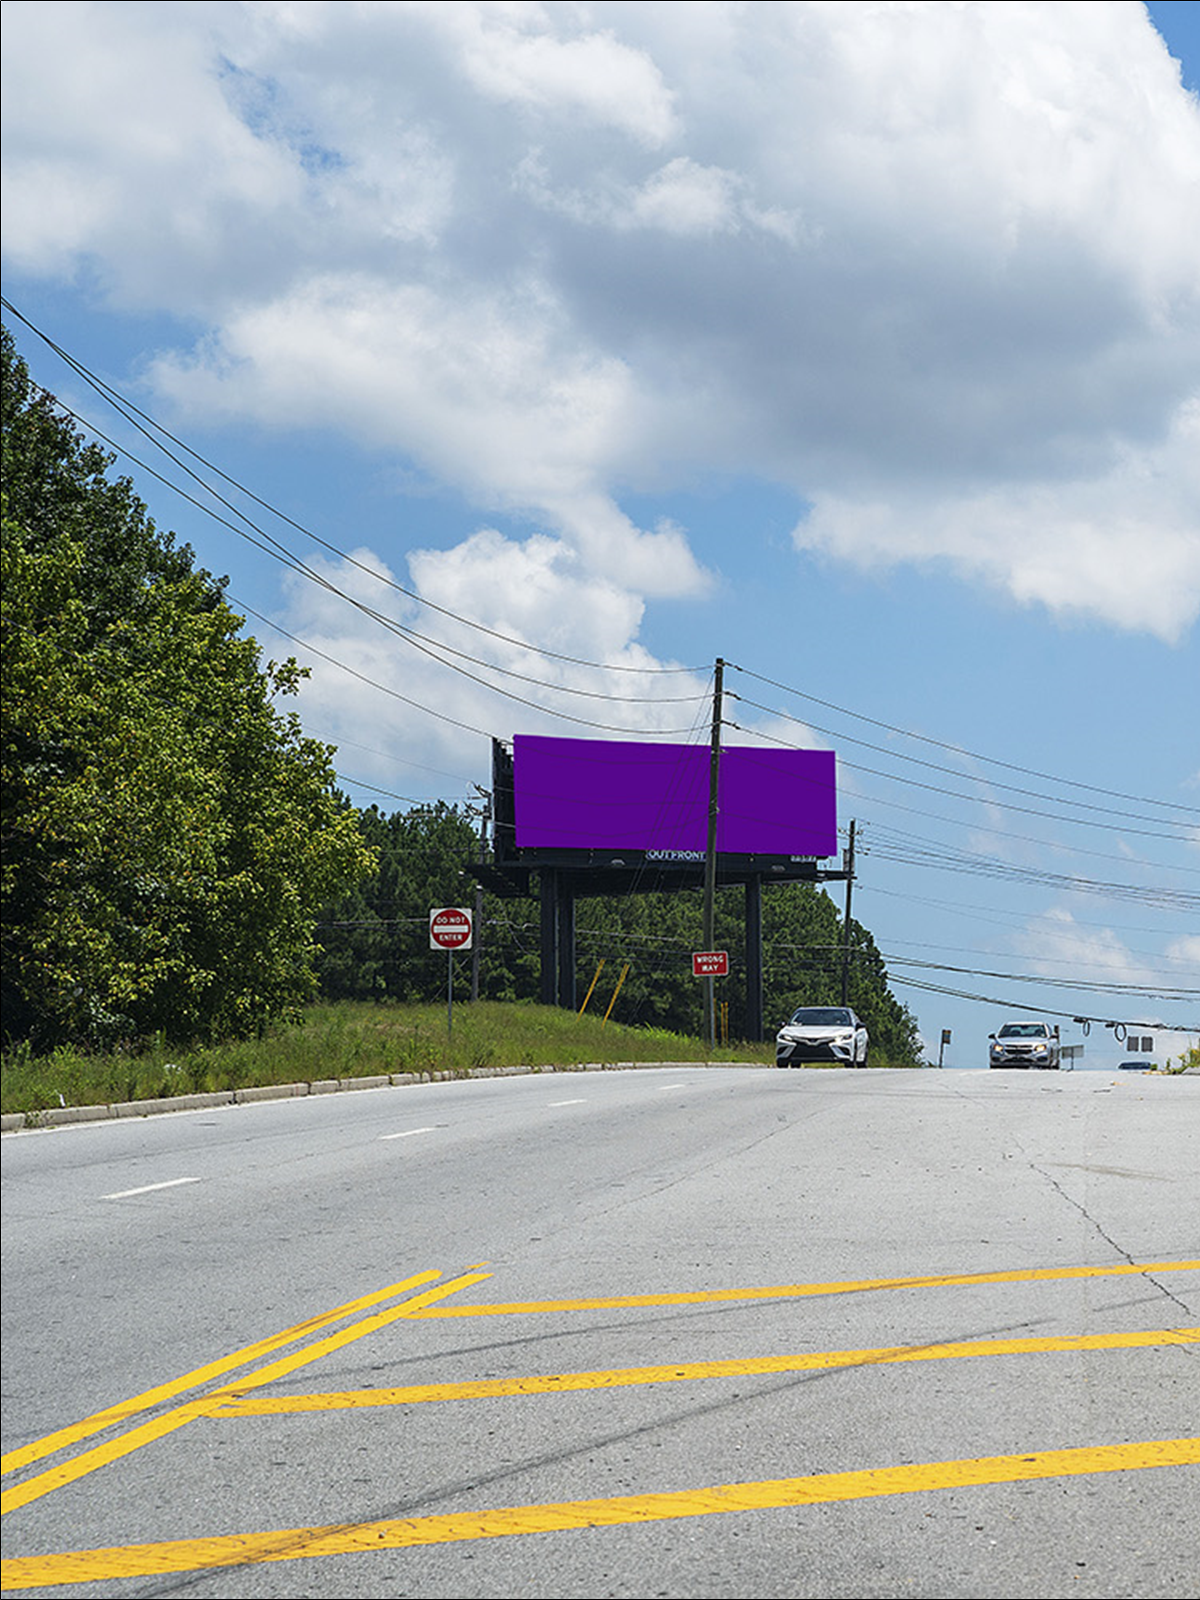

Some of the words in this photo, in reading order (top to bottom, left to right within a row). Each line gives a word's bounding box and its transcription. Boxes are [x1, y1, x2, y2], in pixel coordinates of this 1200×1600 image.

[648, 849, 704, 860] OUTFRONT
[436, 916, 448, 924] DO
[449, 916, 466, 924] NOT
[439, 934, 463, 942] ENTER
[697, 955, 724, 963] WRONG
